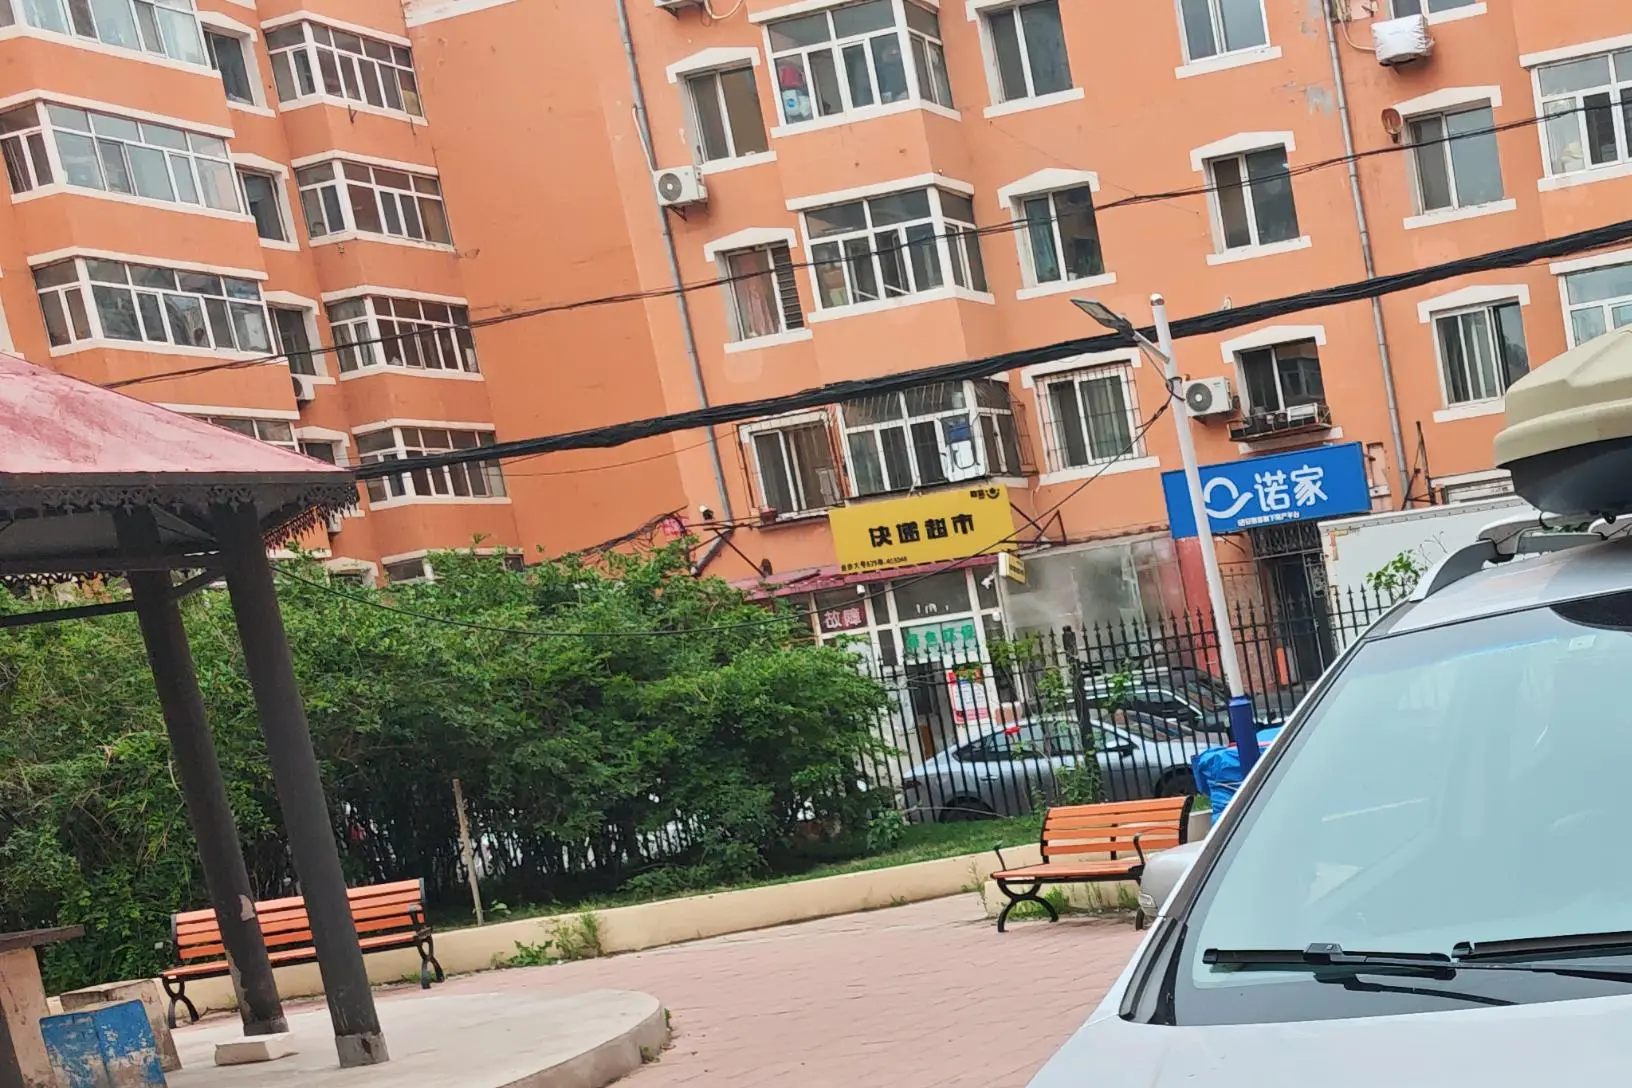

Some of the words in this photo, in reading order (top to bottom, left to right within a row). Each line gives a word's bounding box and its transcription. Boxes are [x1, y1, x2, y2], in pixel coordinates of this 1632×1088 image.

[1254, 464, 1329, 512] 诺家
[868, 513, 975, 548] 快递超市
